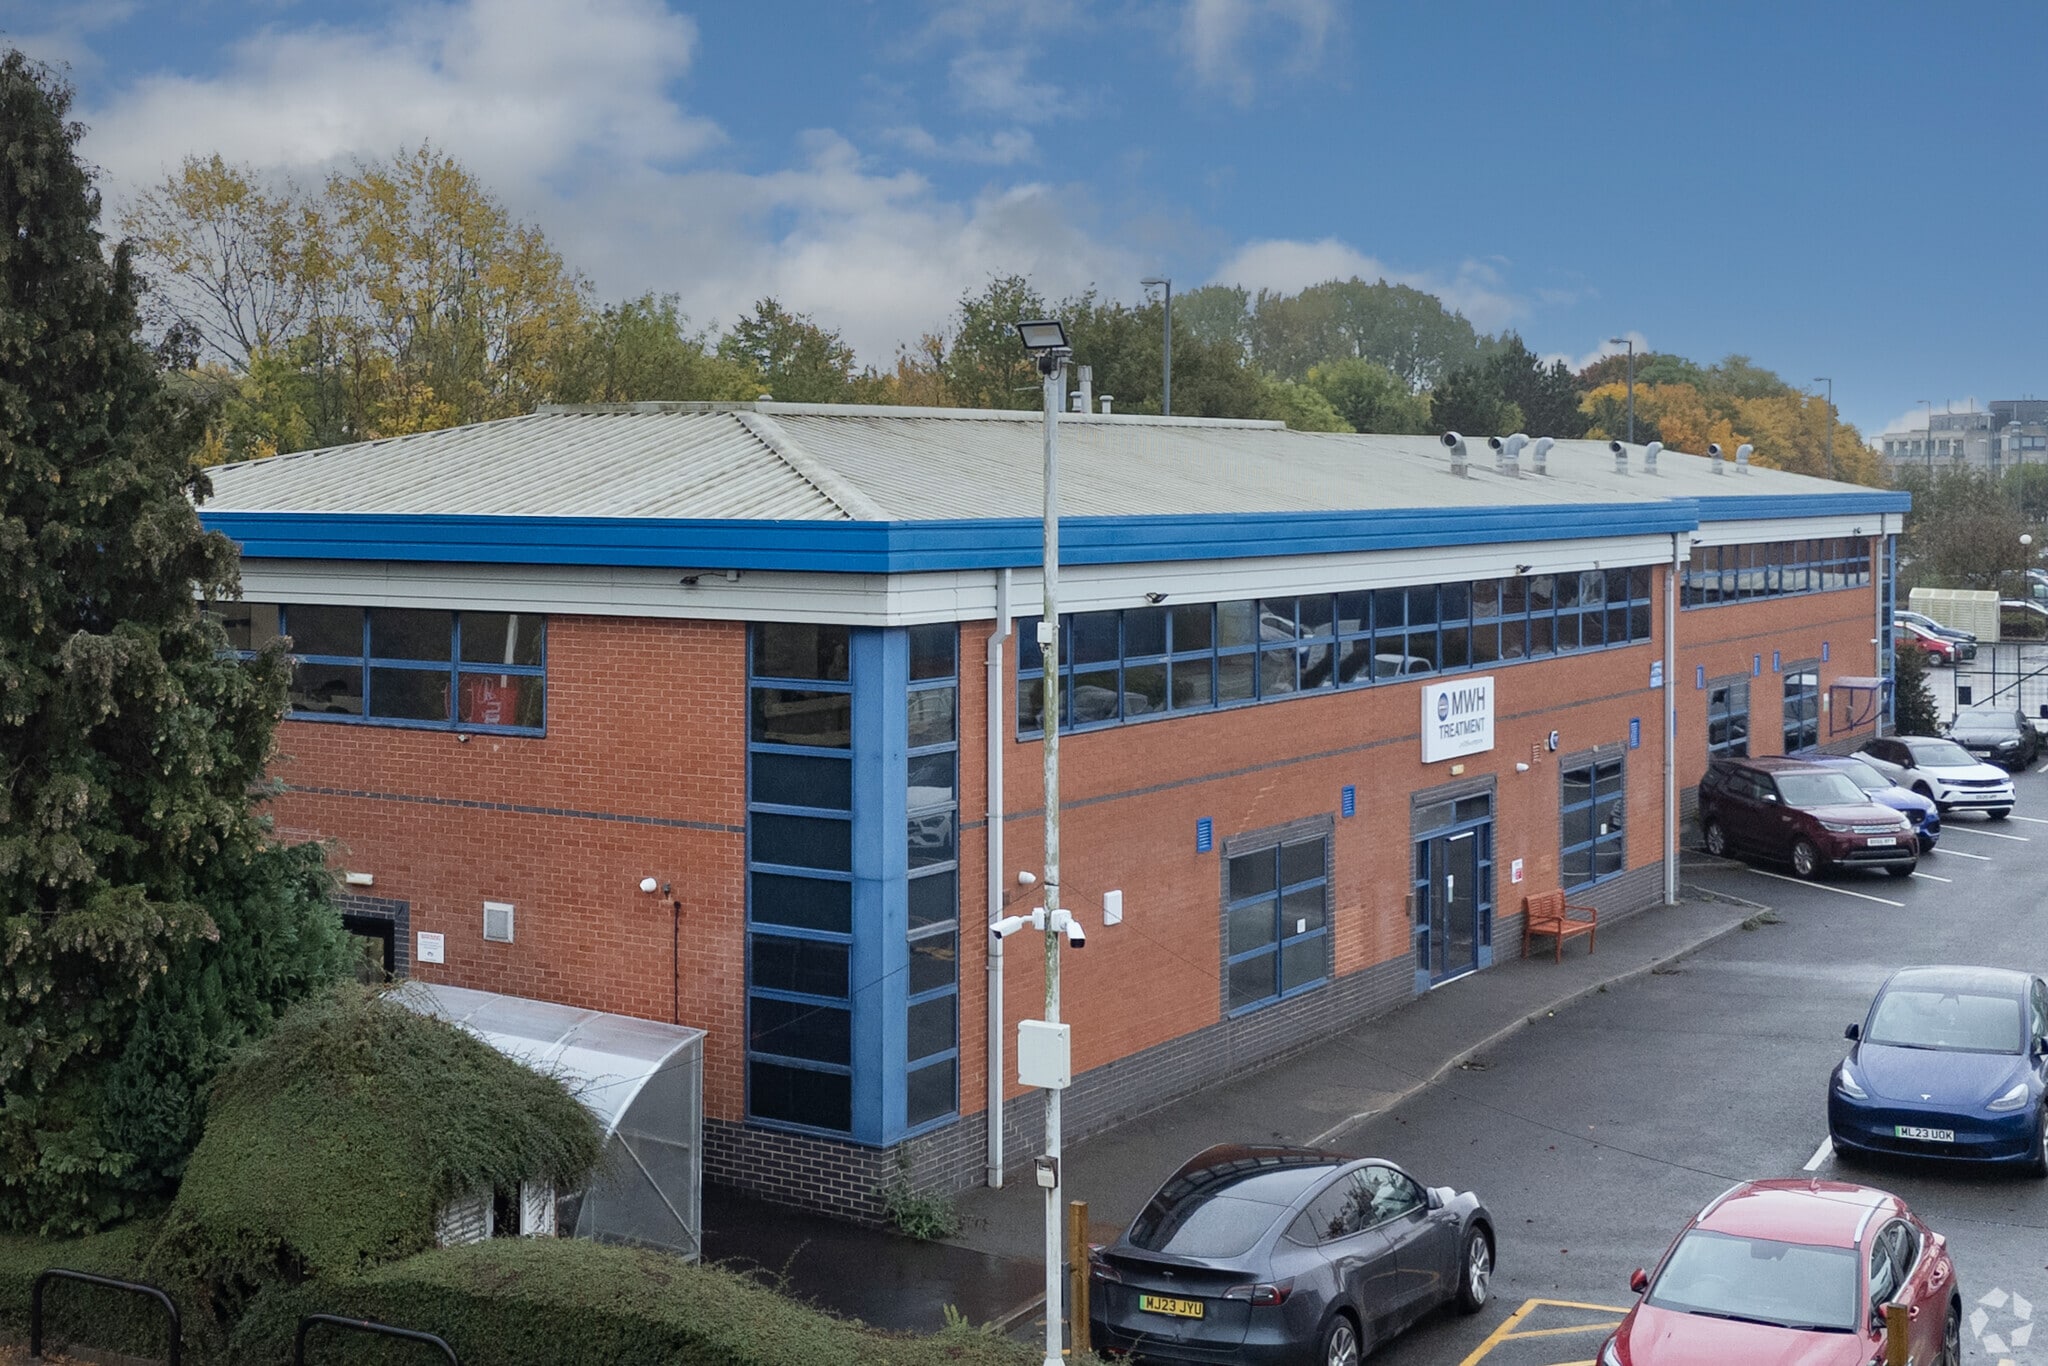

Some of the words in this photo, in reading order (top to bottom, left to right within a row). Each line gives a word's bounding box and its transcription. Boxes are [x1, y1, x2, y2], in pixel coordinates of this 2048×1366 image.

[1452, 686, 1485, 716] MWH
[1439, 717, 1485, 740] TREATMENT
[1901, 1127, 1929, 1138] ML23
[1931, 1130, 1953, 1141] UOK
[1146, 1296, 1177, 1312] MJ23
[1180, 1301, 1202, 1315] JYU
